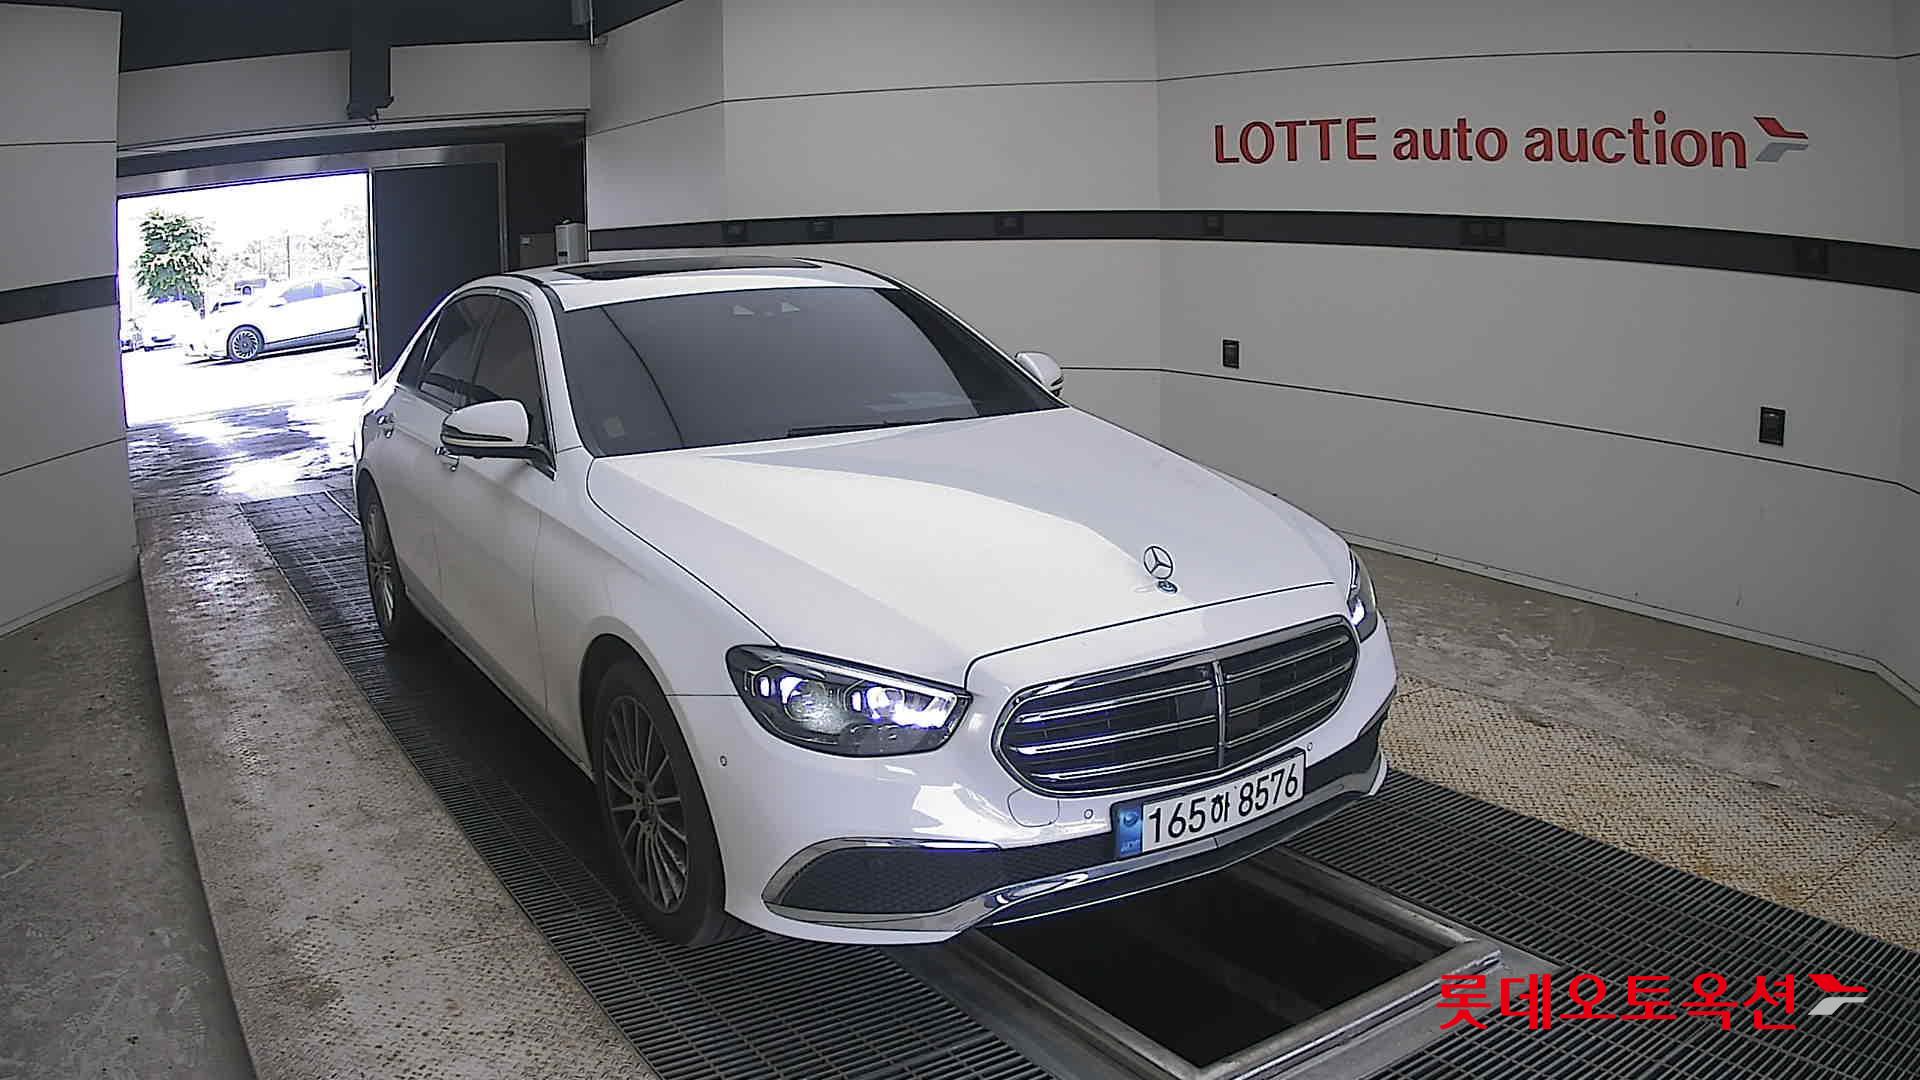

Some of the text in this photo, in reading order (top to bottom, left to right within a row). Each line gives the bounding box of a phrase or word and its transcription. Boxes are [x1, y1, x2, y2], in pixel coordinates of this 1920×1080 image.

[1215, 110, 1747, 169] LOTTE auto auction
[1149, 764, 1298, 843] 165하 8576
